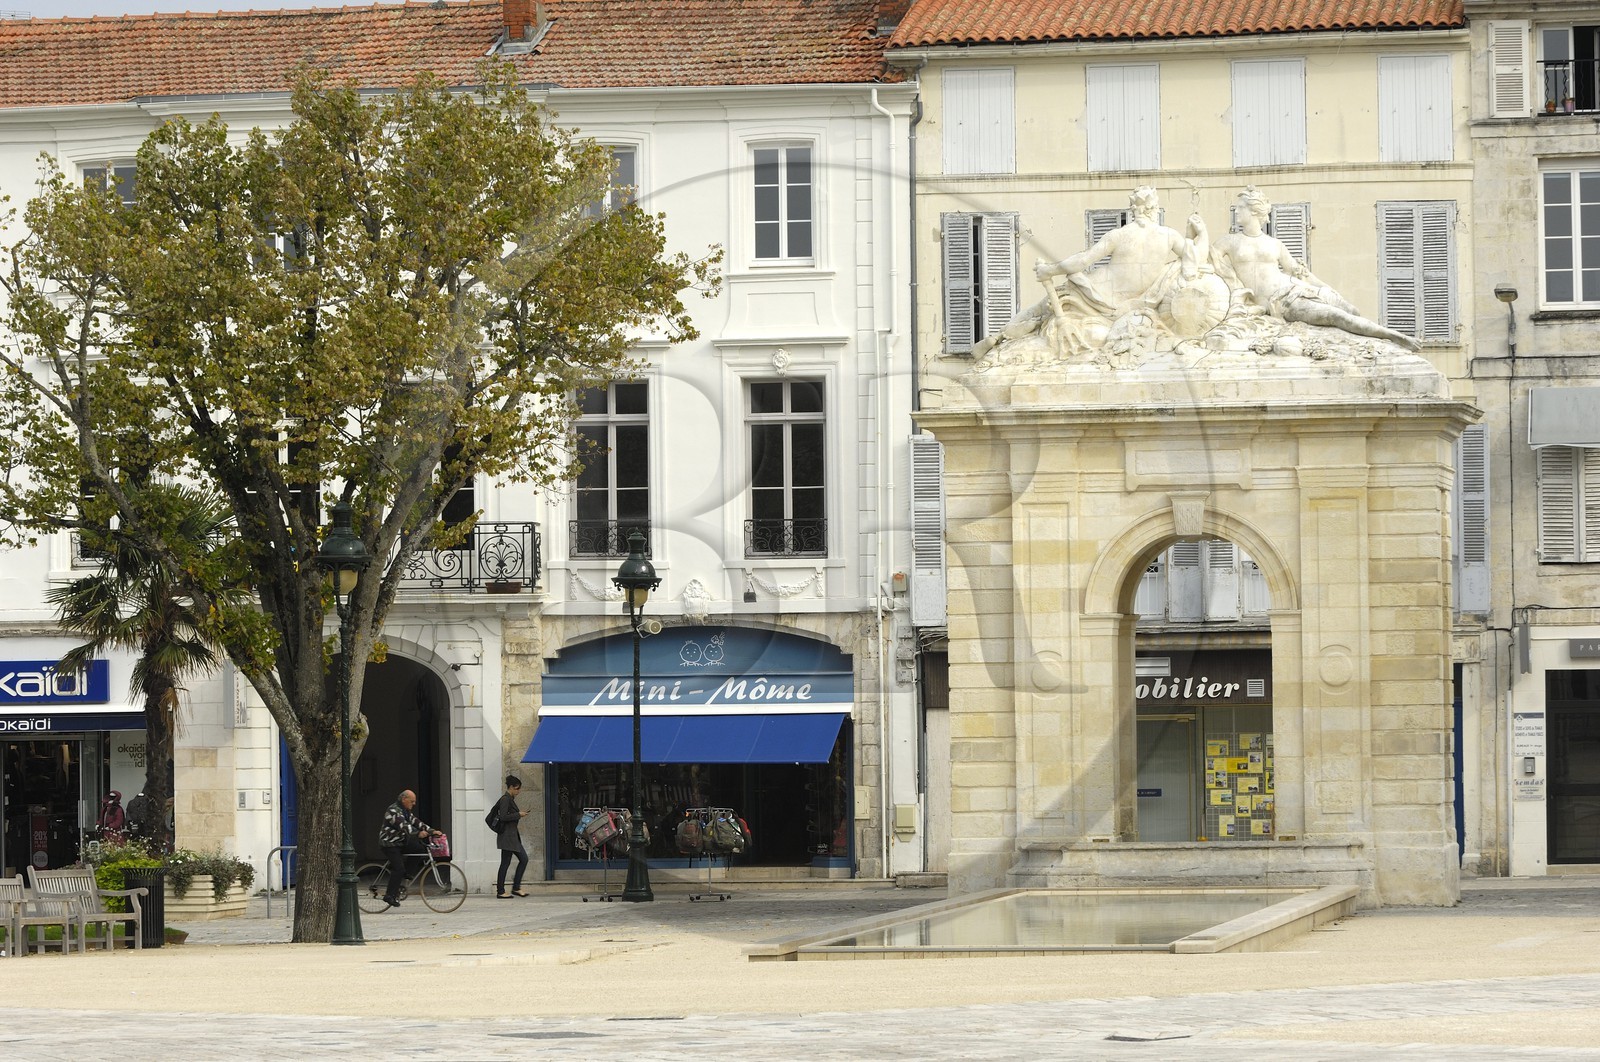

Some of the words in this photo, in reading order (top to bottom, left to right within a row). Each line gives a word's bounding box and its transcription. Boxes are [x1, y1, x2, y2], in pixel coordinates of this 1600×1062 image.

[588, 677, 682, 706] Mini
[705, 677, 812, 706] Môme
[1136, 676, 1240, 699] obilier
[117, 743, 145, 753] okaïdi
